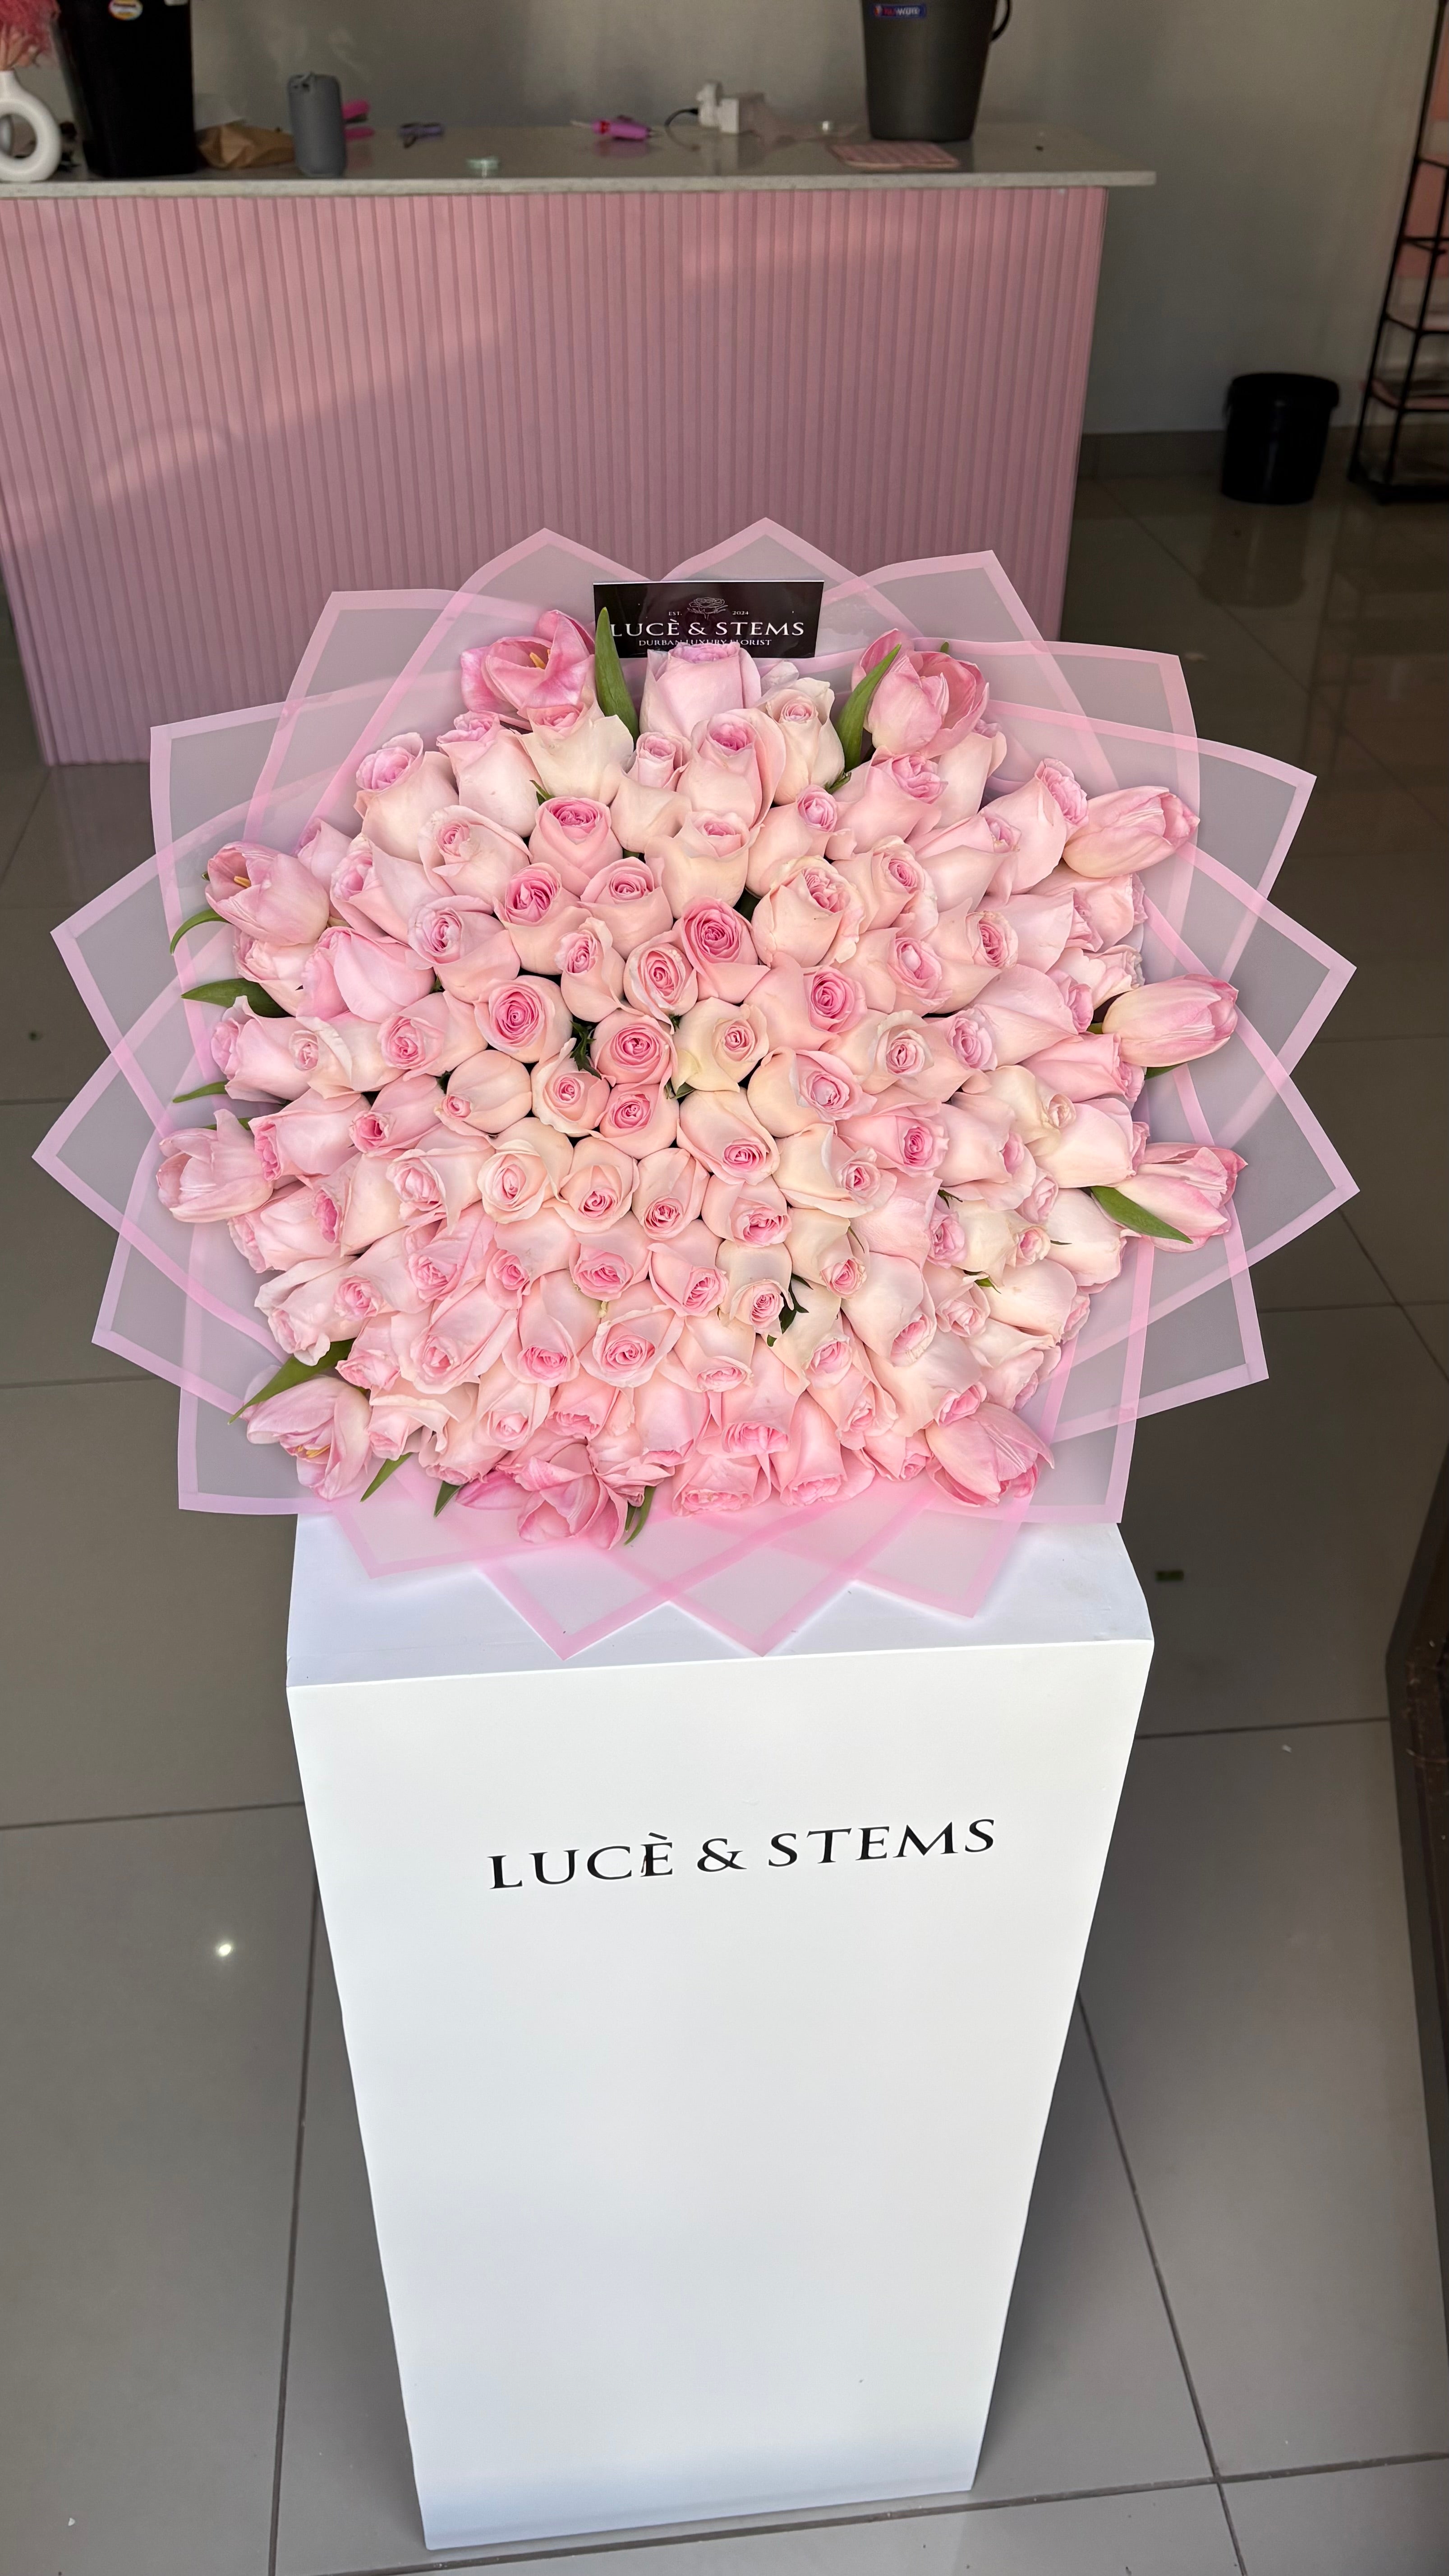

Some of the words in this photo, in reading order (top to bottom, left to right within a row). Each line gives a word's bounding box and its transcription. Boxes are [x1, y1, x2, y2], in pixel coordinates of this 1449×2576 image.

[610, 618, 680, 637] LUCÈ
[688, 622, 708, 636] &
[715, 622, 805, 636] STEMS
[488, 1831, 673, 1889] LUCÈ
[697, 1838, 747, 1872] &
[768, 1818, 994, 1867] STEMS
